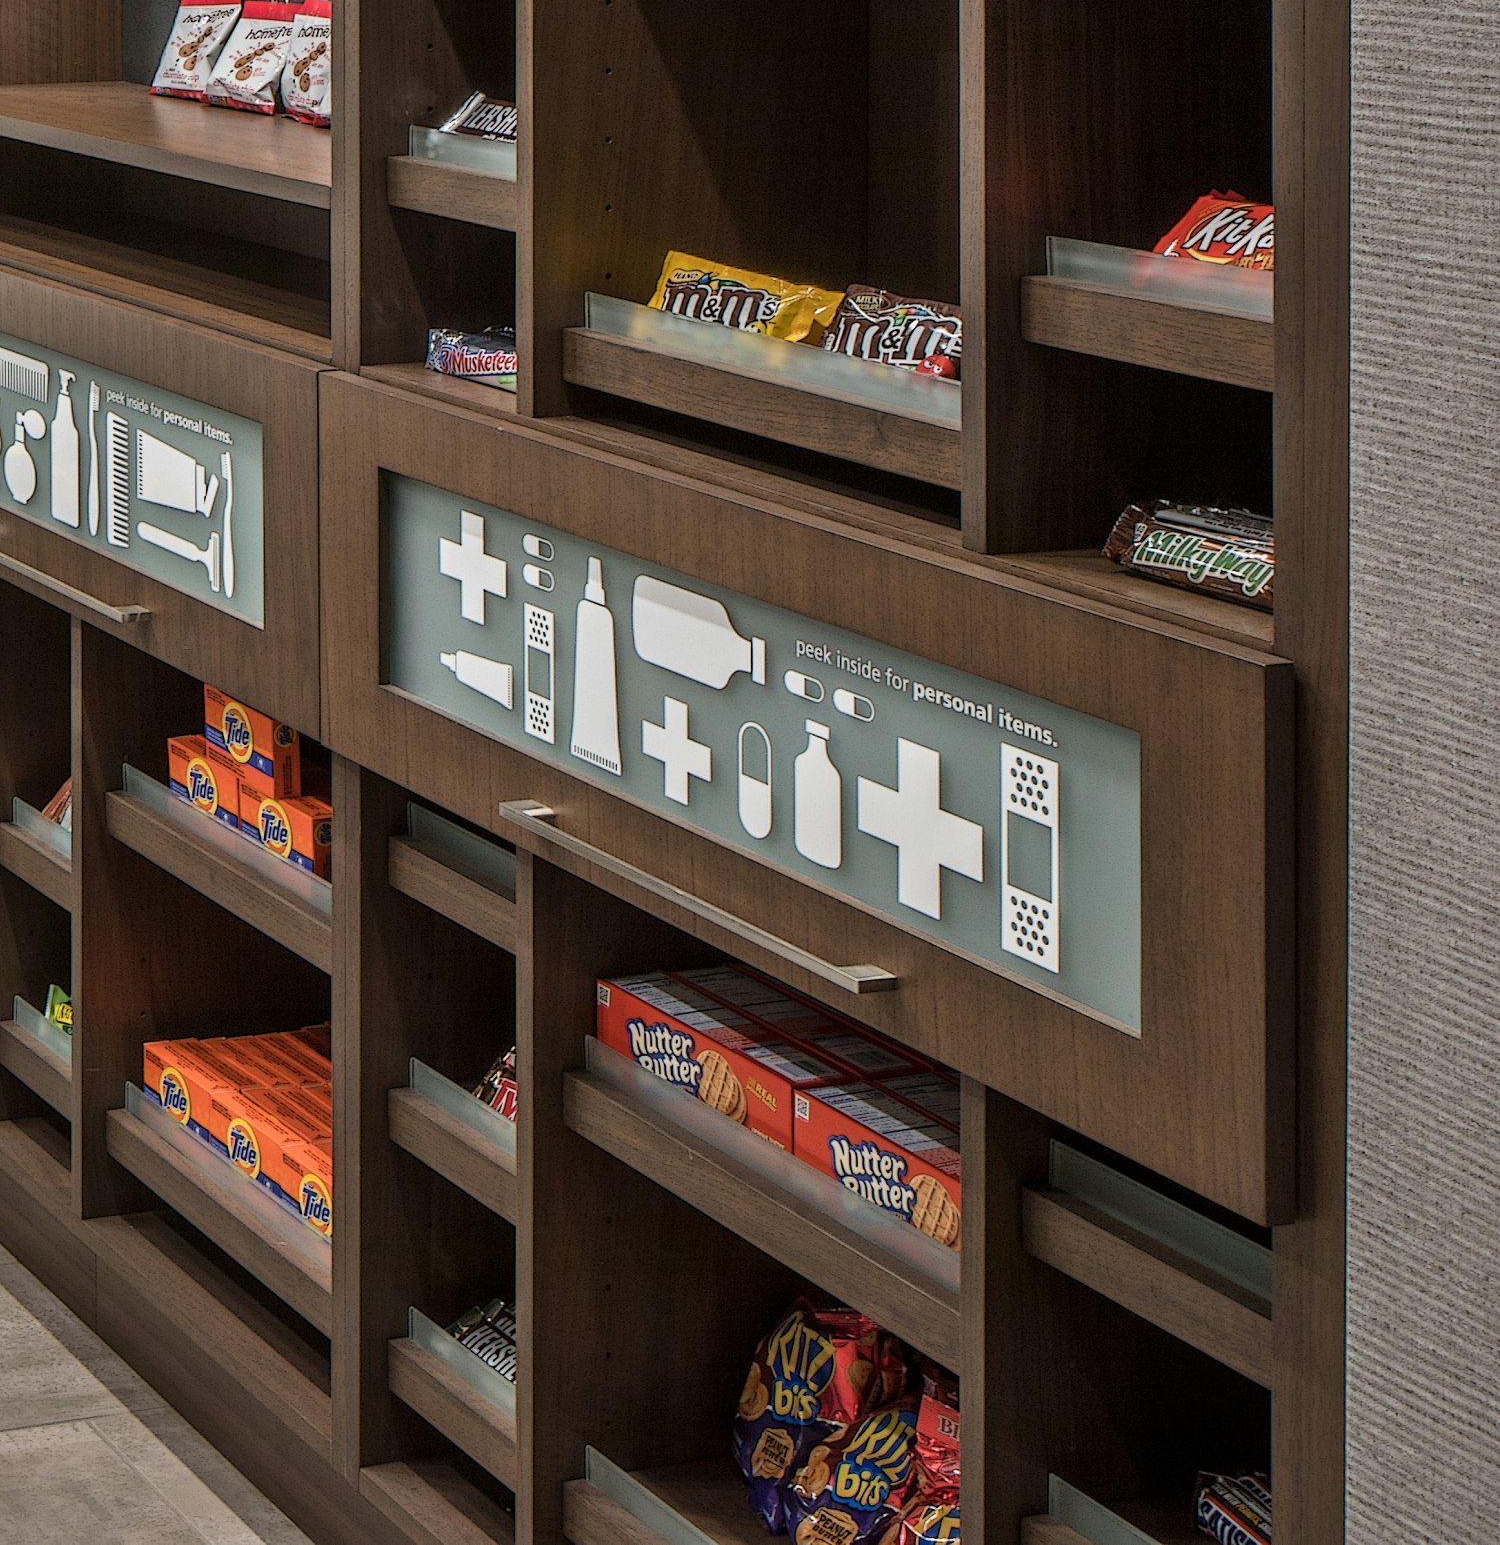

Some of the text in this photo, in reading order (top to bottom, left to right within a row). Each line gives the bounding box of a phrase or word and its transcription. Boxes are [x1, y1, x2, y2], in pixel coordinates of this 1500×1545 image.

[245, 26, 293, 40] homefre
[462, 102, 517, 136] HERSHE
[441, 349, 452, 374] 3
[107, 390, 233, 445] peek inside for personal items.
[795, 639, 1059, 748] peek inside for personal items.
[225, 715, 251, 748] Tide
[190, 771, 215, 802] Tide
[261, 811, 289, 844] Tide
[628, 1022, 693, 1058] Nutter
[640, 1056, 701, 1086] Butter
[162, 1079, 187, 1112] Tide
[230, 1131, 257, 1166] Tide
[830, 1139, 905, 1183] Nutter
[303, 1186, 331, 1225] Tide
[842, 1176, 914, 1213] Butter
[461, 1324, 517, 1385] HERSHE
[766, 1311, 837, 1392] RITZ
[761, 1447, 787, 1465] BUTTER
[764, 1434, 790, 1457] PEANUT
[842, 1409, 916, 1483] RITZ
[836, 1463, 889, 1506] bits
[817, 1513, 853, 1540] PEANUT
